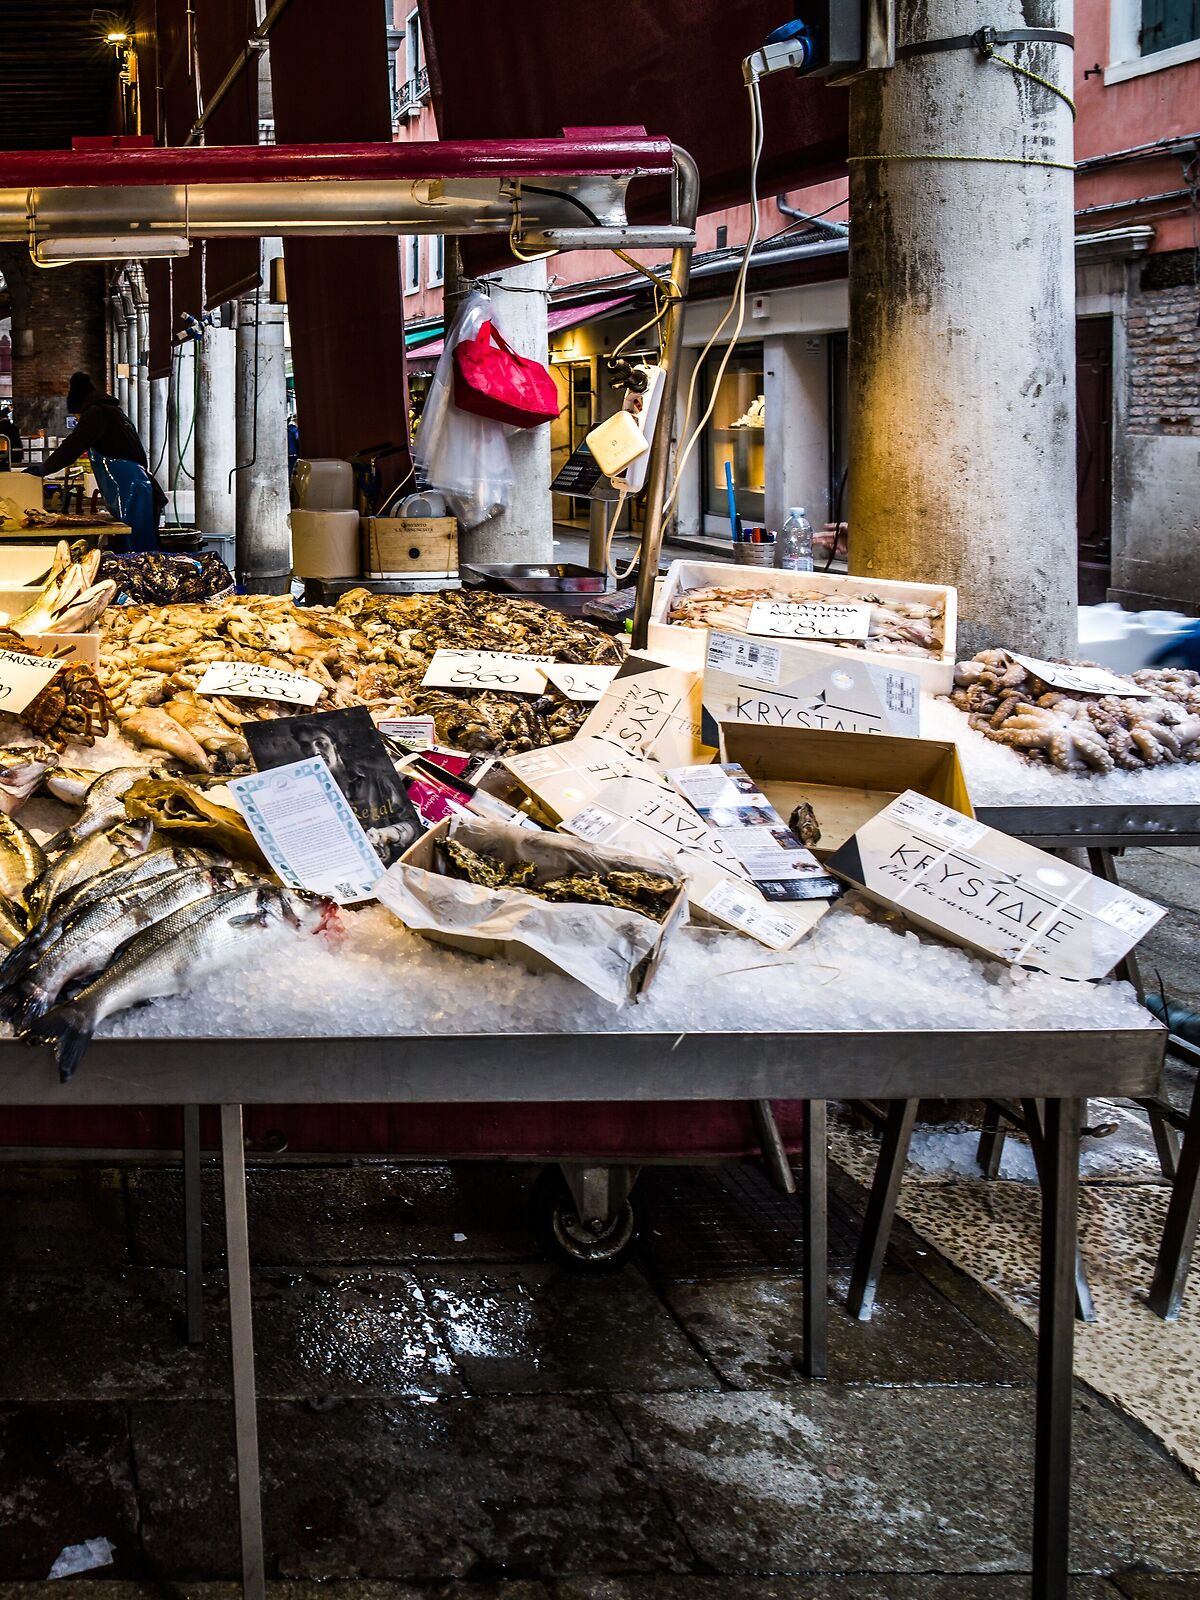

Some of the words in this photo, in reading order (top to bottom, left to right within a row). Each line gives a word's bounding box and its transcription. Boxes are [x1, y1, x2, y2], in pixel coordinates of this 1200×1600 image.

[736, 697, 882, 733] KRYST
[637, 800, 736, 861] STALE
[890, 843, 1074, 943] KRYSTALE
